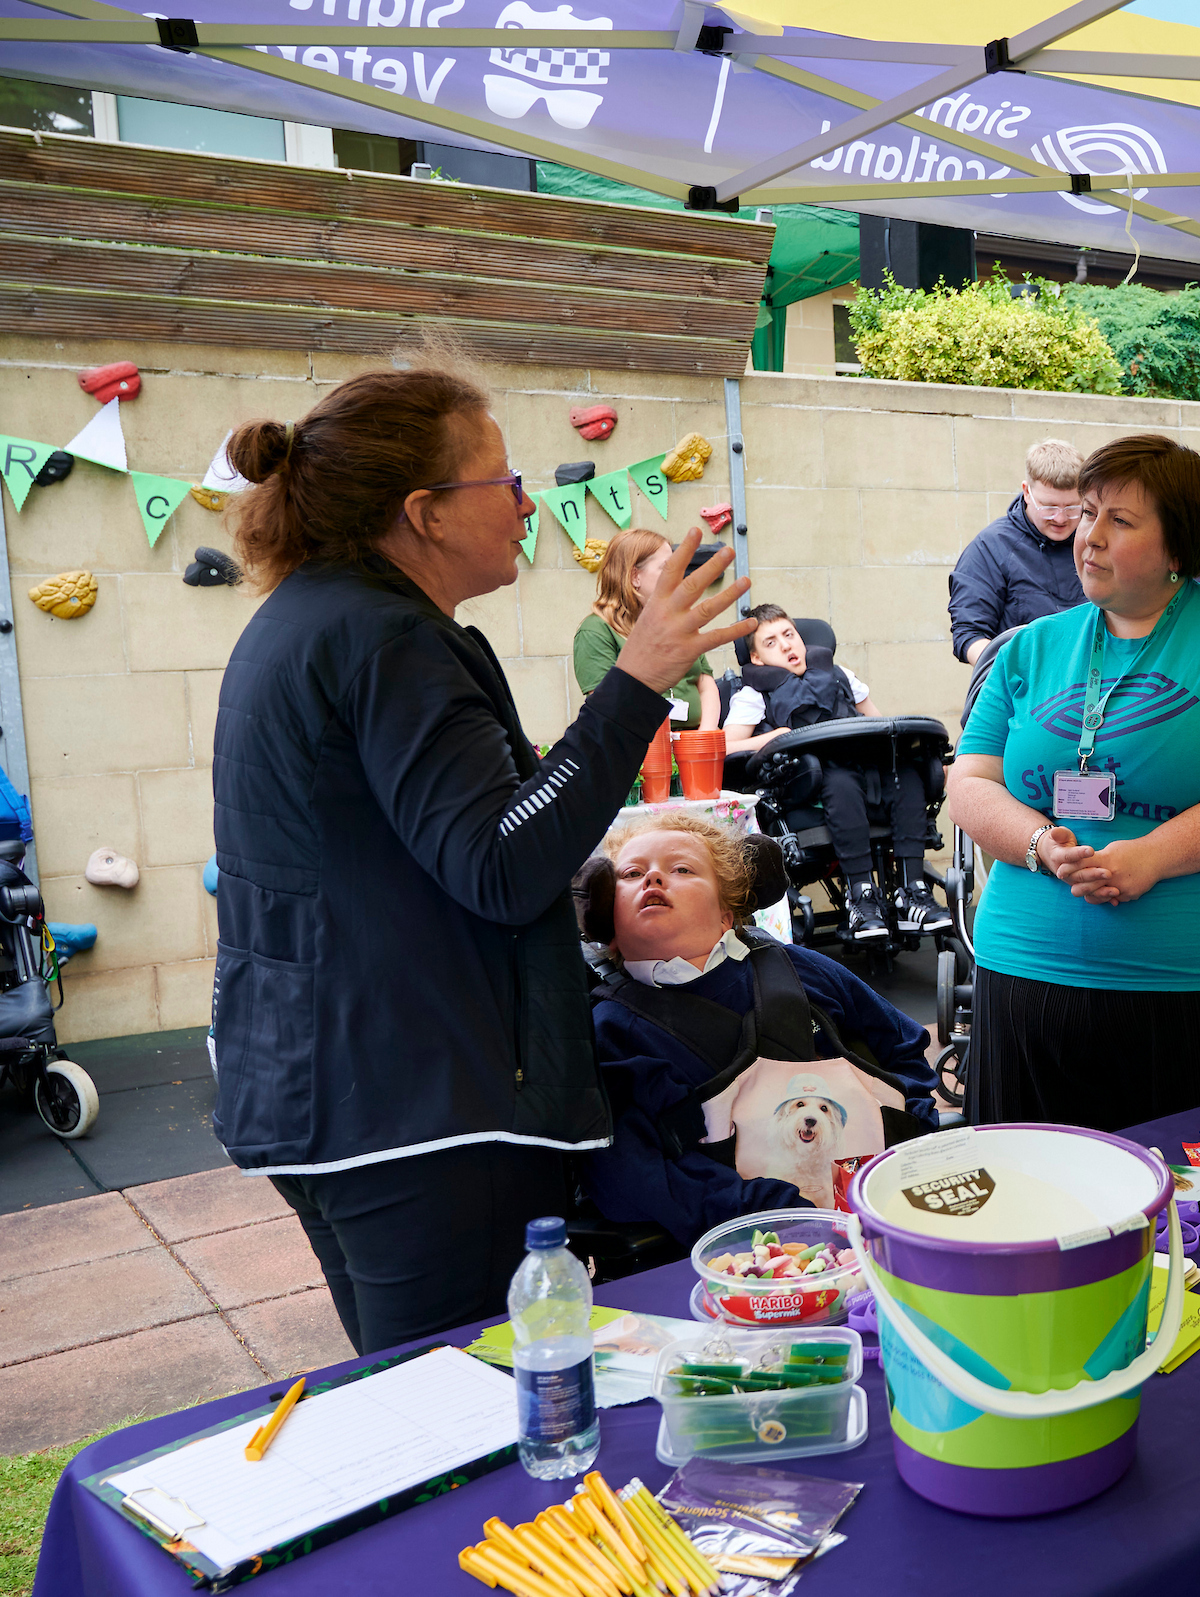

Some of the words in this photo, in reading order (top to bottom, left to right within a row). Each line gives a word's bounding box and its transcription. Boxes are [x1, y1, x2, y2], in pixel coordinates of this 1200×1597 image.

[1021, 756, 1126, 801] Sit
[911, 1169, 982, 1196] SECURITY
[924, 1182, 989, 1210] SEAL
[750, 1294, 803, 1310] HARIBO
[754, 1309, 801, 1320] Supermix
[673, 1504, 728, 1520] Scotland
